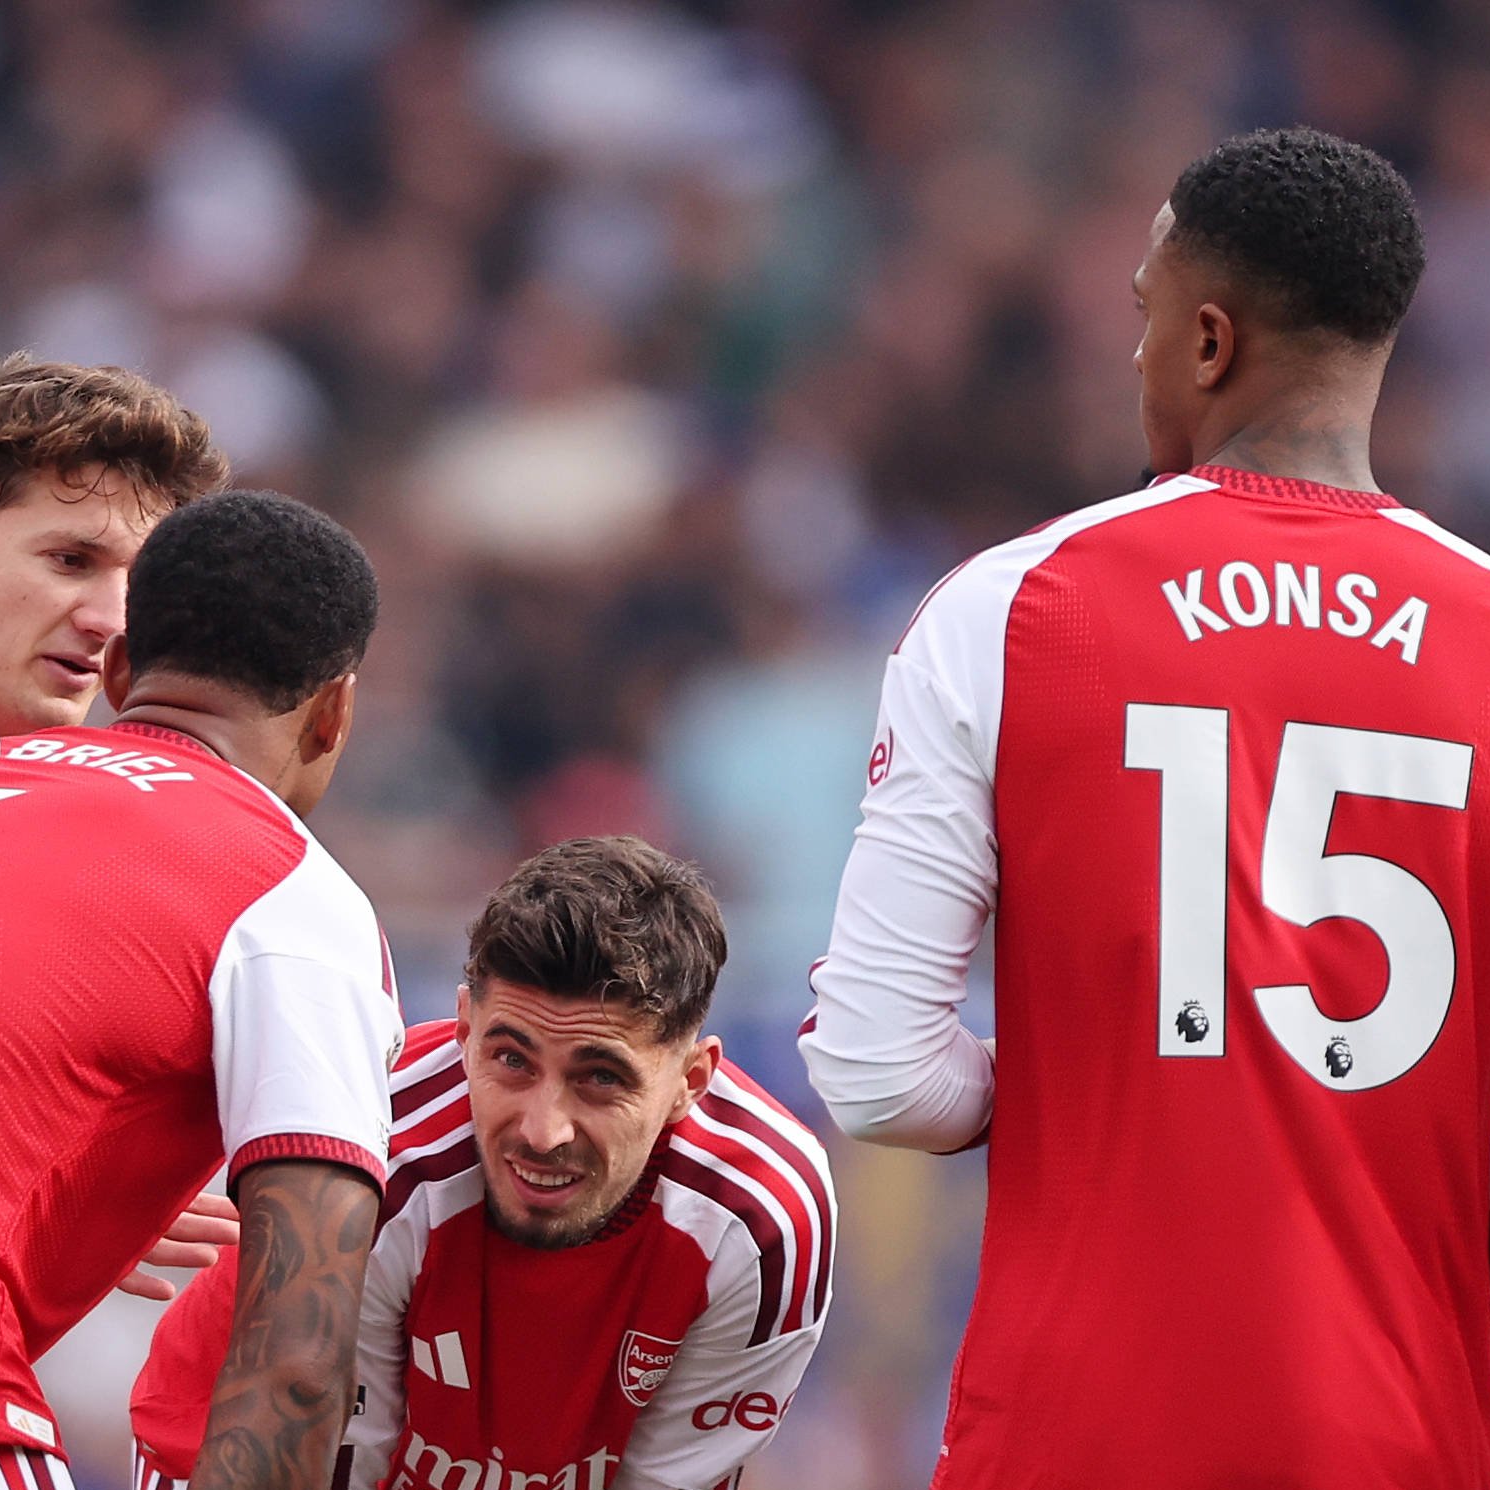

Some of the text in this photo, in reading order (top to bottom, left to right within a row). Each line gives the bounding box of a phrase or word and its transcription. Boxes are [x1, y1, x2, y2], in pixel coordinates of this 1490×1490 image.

[1161, 560, 1428, 665] KONSA
[1123, 703, 1474, 1092] 15
[630, 1345, 678, 1365] Arsen
[691, 1390, 797, 1432] de
